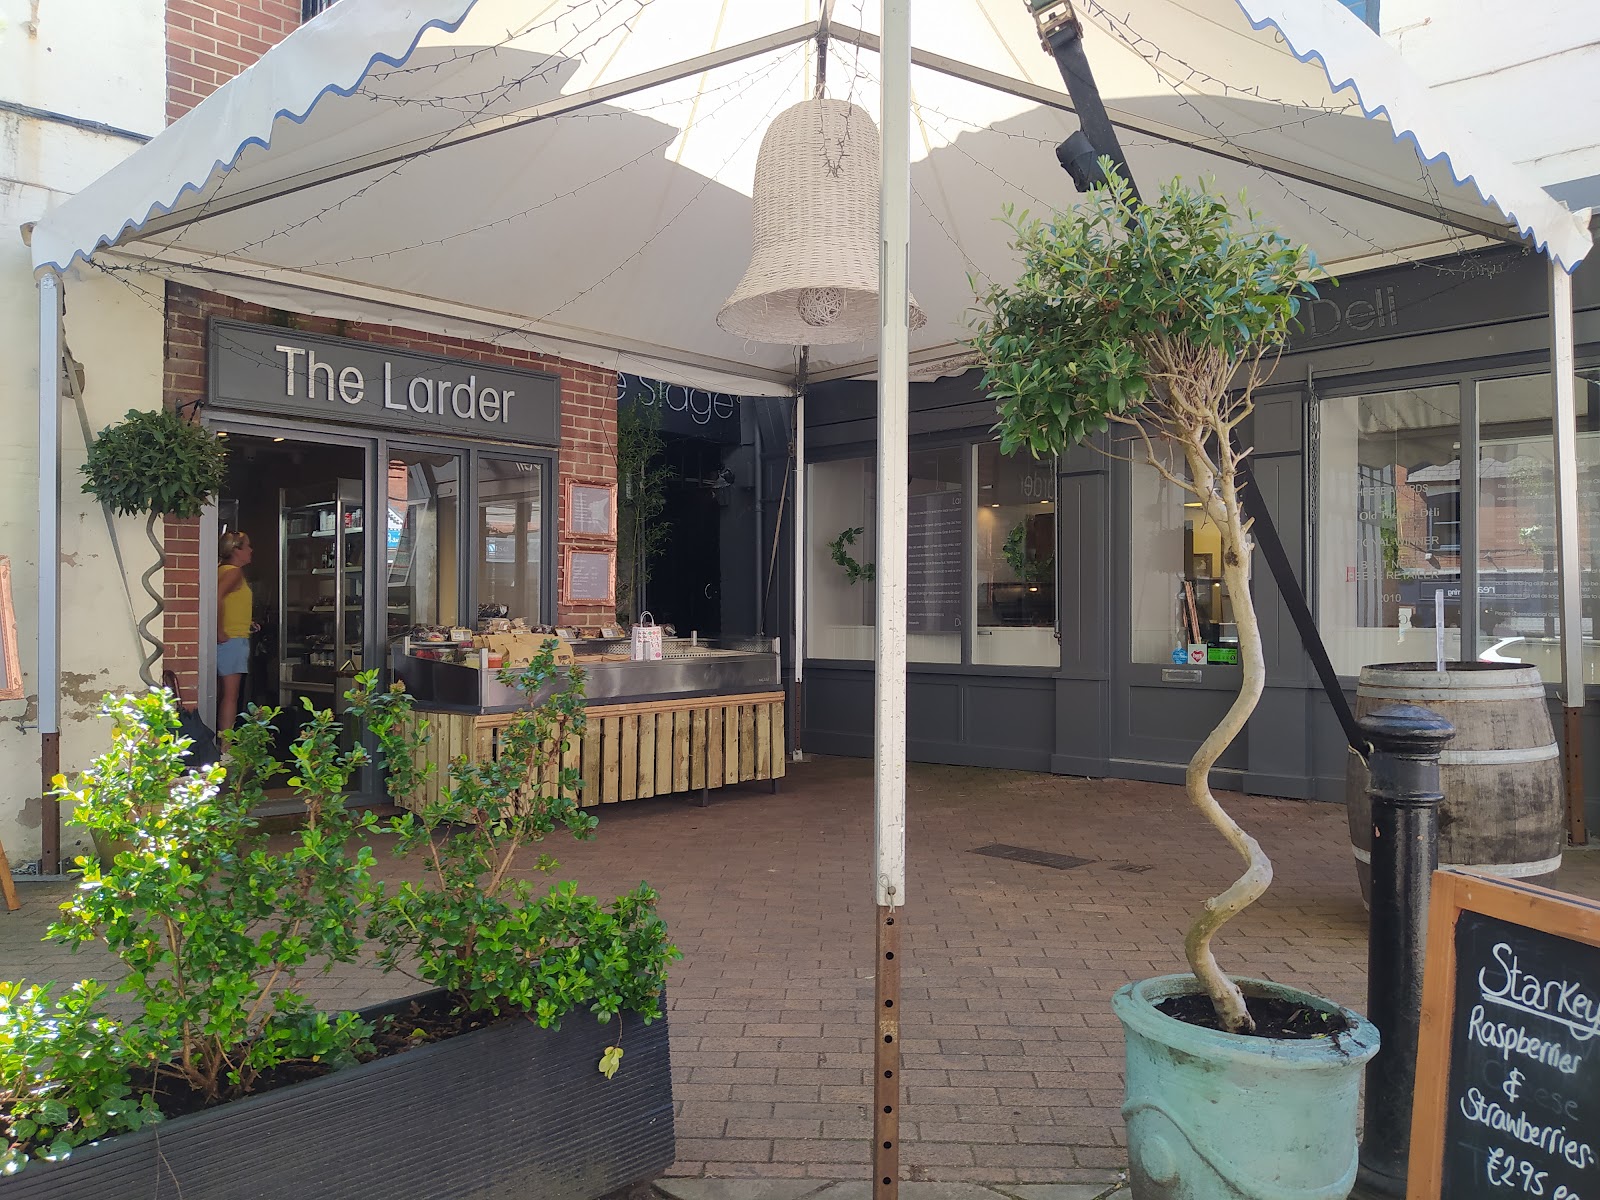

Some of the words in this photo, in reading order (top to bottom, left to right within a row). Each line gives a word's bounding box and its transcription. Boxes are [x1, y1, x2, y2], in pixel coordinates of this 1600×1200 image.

[1308, 286, 1398, 339] Deli
[275, 344, 365, 405] The
[384, 362, 516, 423] Larder
[1353, 486, 1386, 497] HEESE
[1359, 511, 1377, 521] Old
[1395, 536, 1439, 546] WINNER
[1386, 570, 1439, 581] RETAILER
[1468, 1005, 1582, 1074] Raspberries
[1502, 1067, 1526, 1102] &
